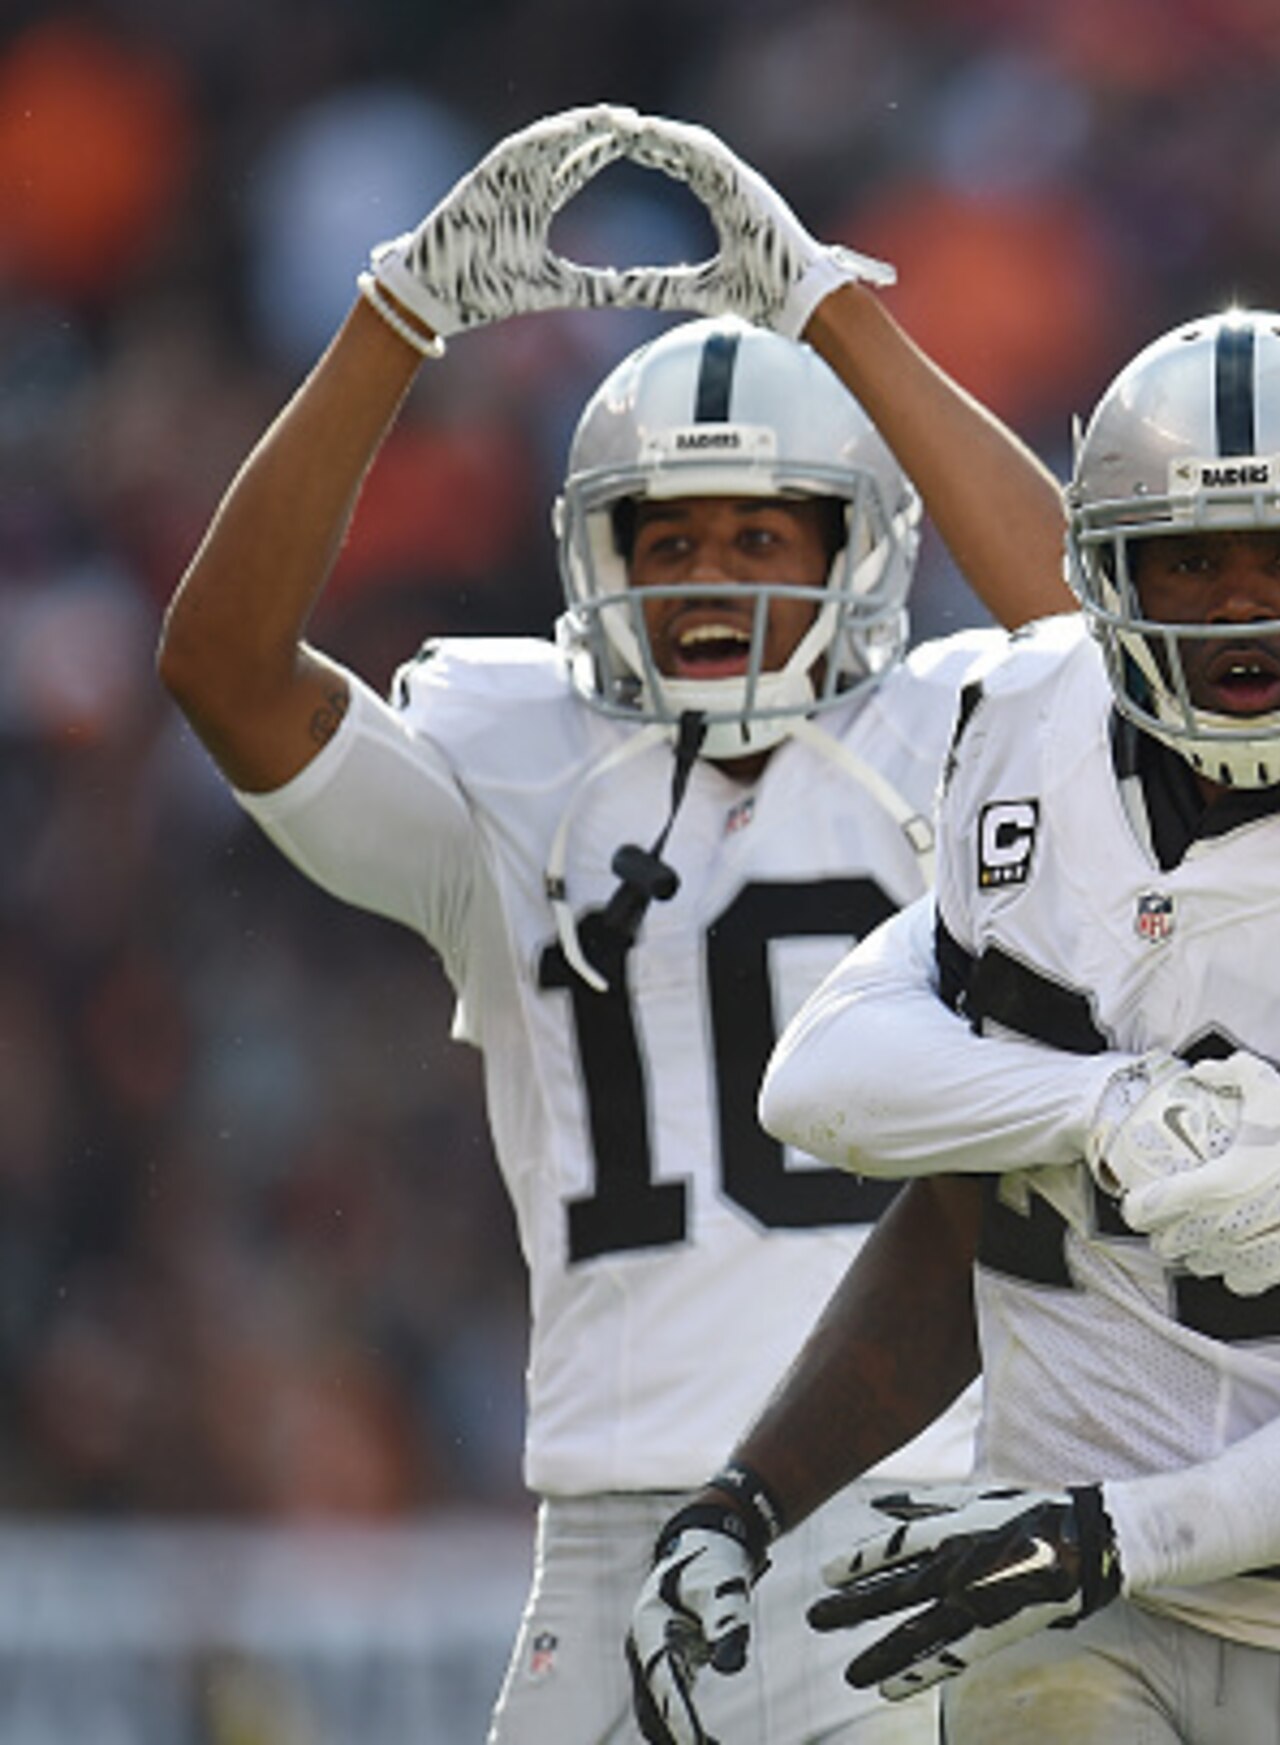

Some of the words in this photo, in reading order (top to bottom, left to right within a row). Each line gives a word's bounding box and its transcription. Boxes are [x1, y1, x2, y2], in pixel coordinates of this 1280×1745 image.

[676, 433, 740, 448] RAIDERS
[1201, 465, 1268, 487] RAIDERS
[982, 804, 1036, 867] C
[539, 877, 914, 1264] 10
